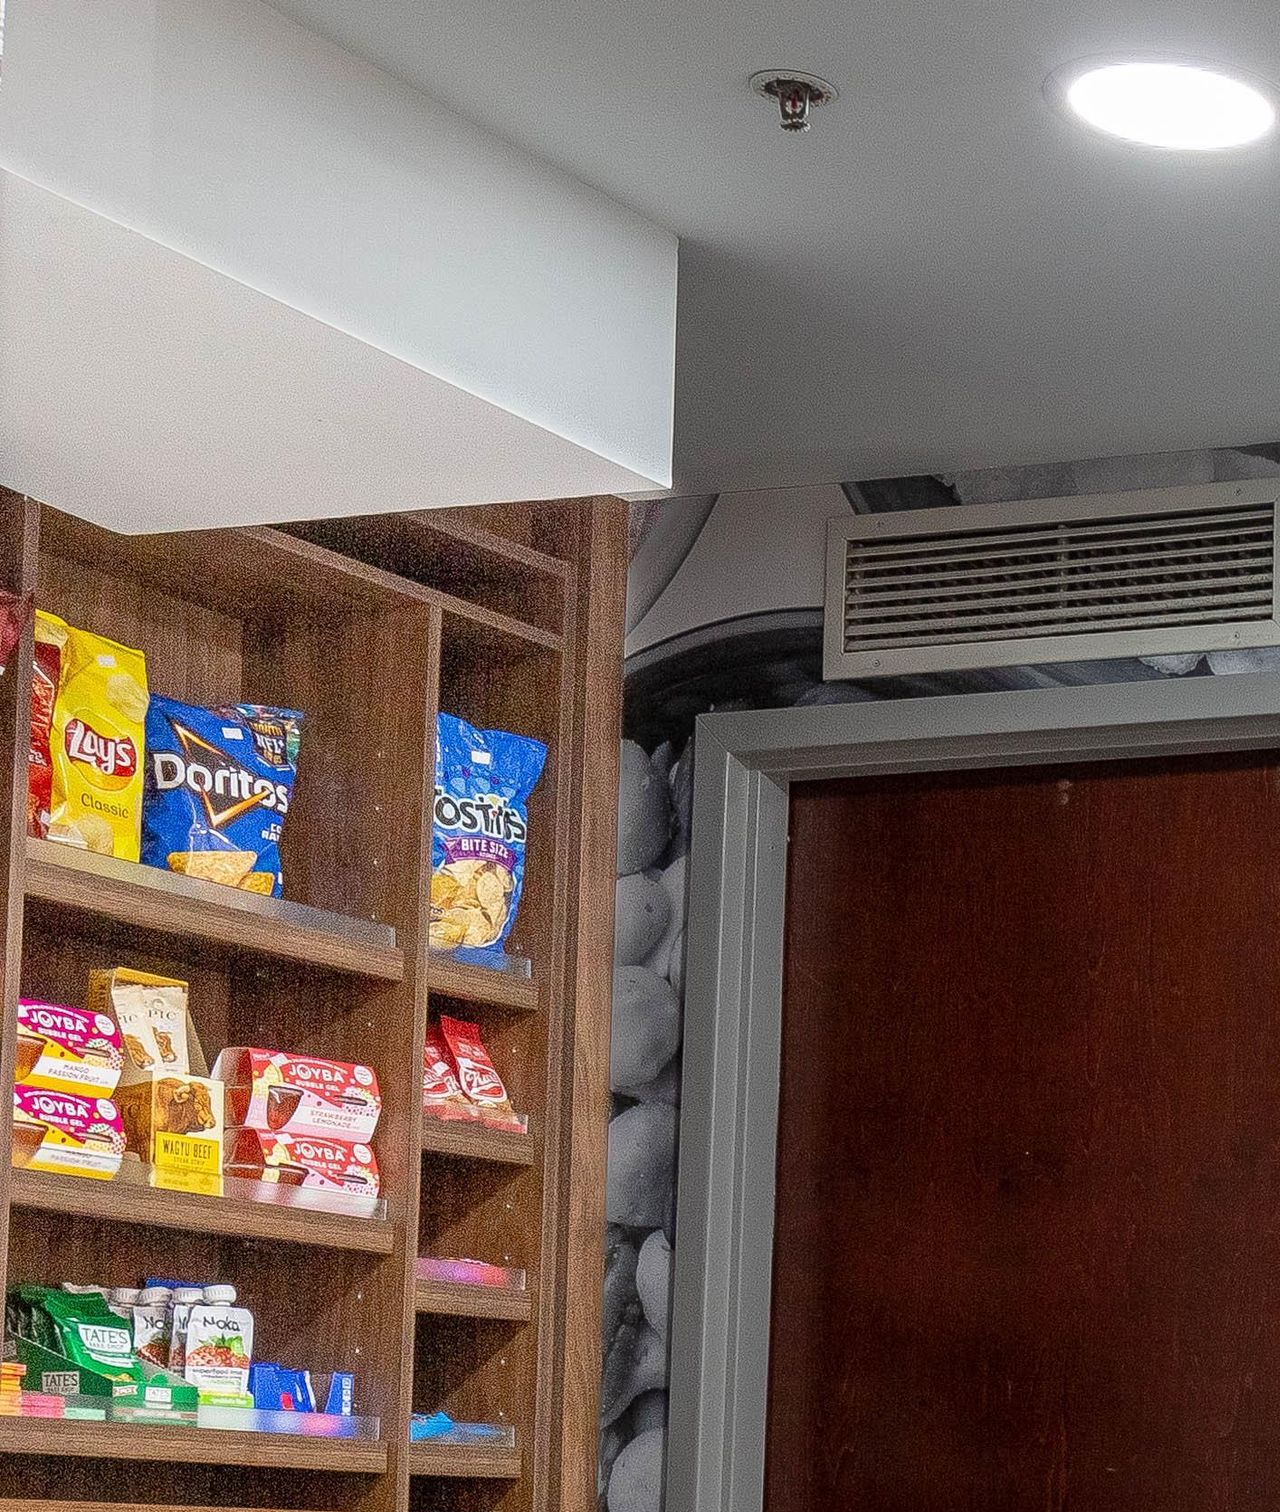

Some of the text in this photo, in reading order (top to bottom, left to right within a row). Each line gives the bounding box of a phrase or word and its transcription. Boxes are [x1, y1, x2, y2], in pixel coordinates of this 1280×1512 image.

[68, 720, 134, 775] Lay's
[153, 752, 288, 813] Doritos
[81, 792, 129, 819] Classic
[461, 838, 488, 852] BITE
[30, 1011, 87, 1033] JOYBA
[48, 1069, 78, 1080] PASSION
[289, 1064, 345, 1084] JOYBA
[32, 1096, 89, 1118] JOYBA
[162, 1139, 213, 1160] WAGYU BEEF
[295, 1143, 346, 1161] JOYBA
[203, 1315, 241, 1332] Noka
[82, 1327, 128, 1344] TATE'S
[43, 1374, 78, 1387] TATE'S
